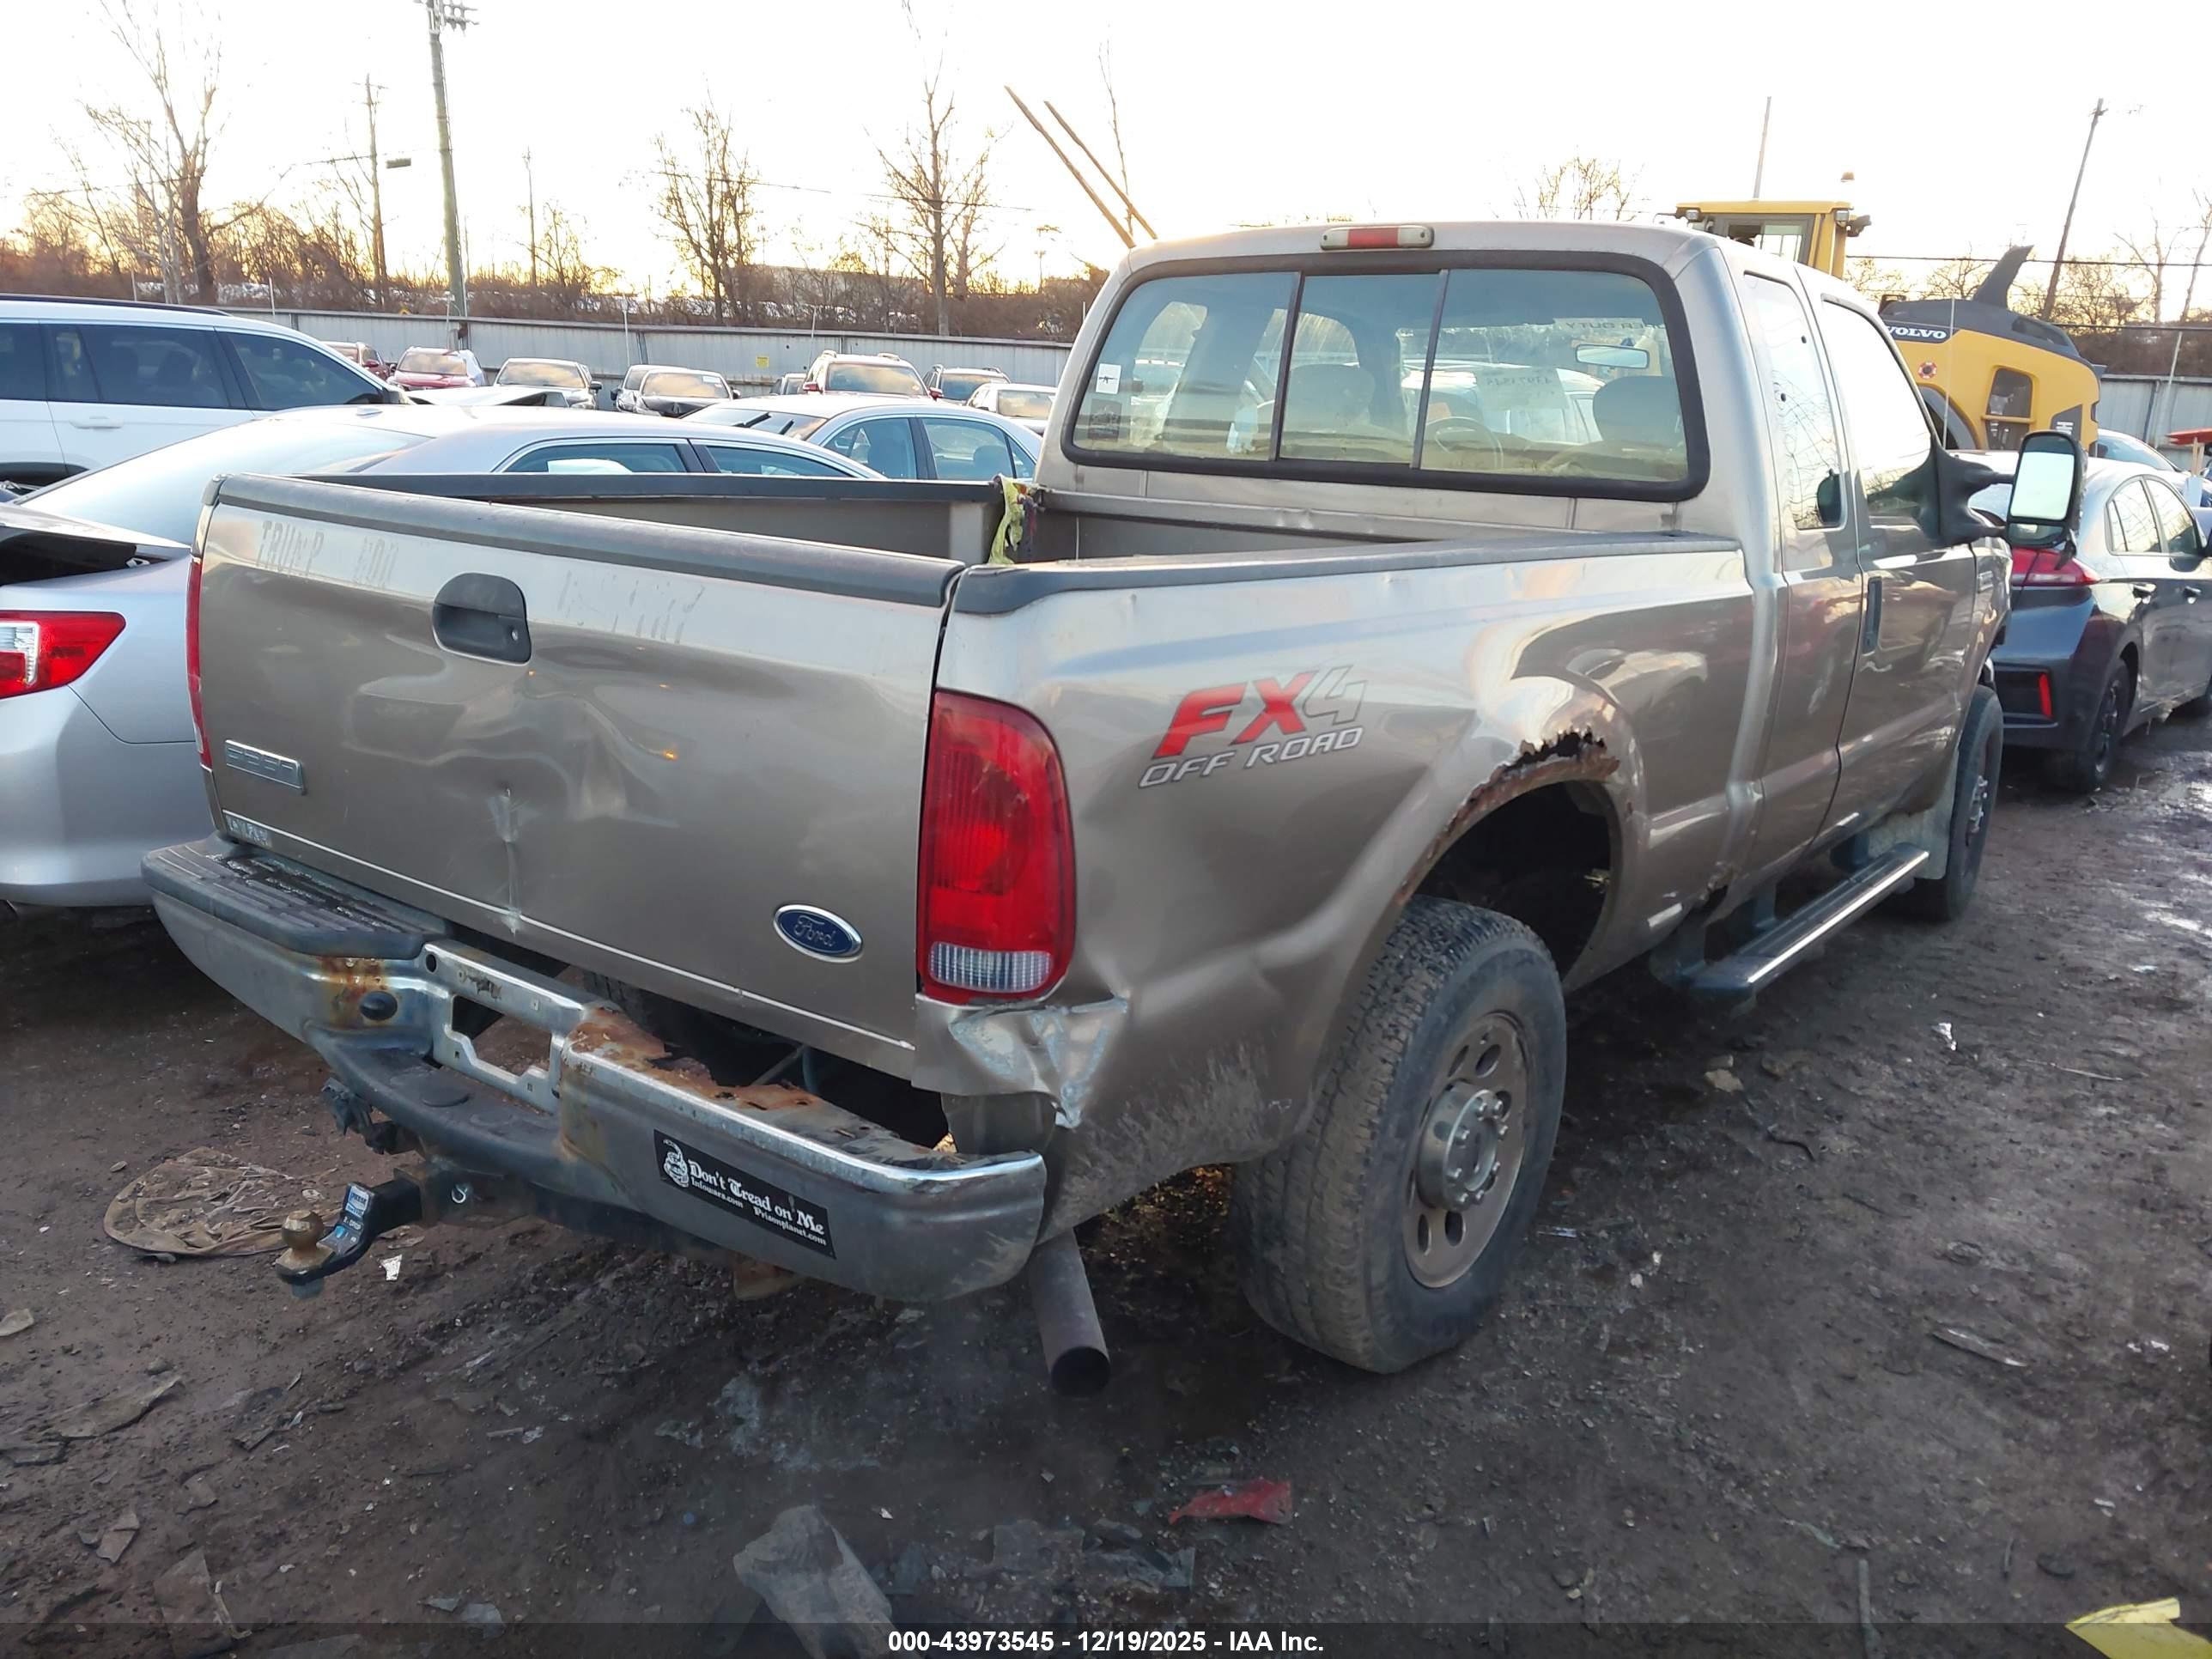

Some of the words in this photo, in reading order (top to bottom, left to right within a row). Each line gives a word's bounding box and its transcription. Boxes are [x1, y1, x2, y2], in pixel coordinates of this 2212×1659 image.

[1887, 326, 1947, 339] VOLVO
[1152, 665, 1367, 759] FX4
[1138, 750, 1237, 788] OFF
[1243, 726, 1364, 769] ROAD
[793, 915, 836, 946] Ford
[688, 1159, 726, 1189] Don't
[728, 1178, 772, 1212] Tread
[775, 1205, 793, 1221] on
[796, 1210, 824, 1235] Me
[753, 1206, 827, 1245] Prisonplanet.com
